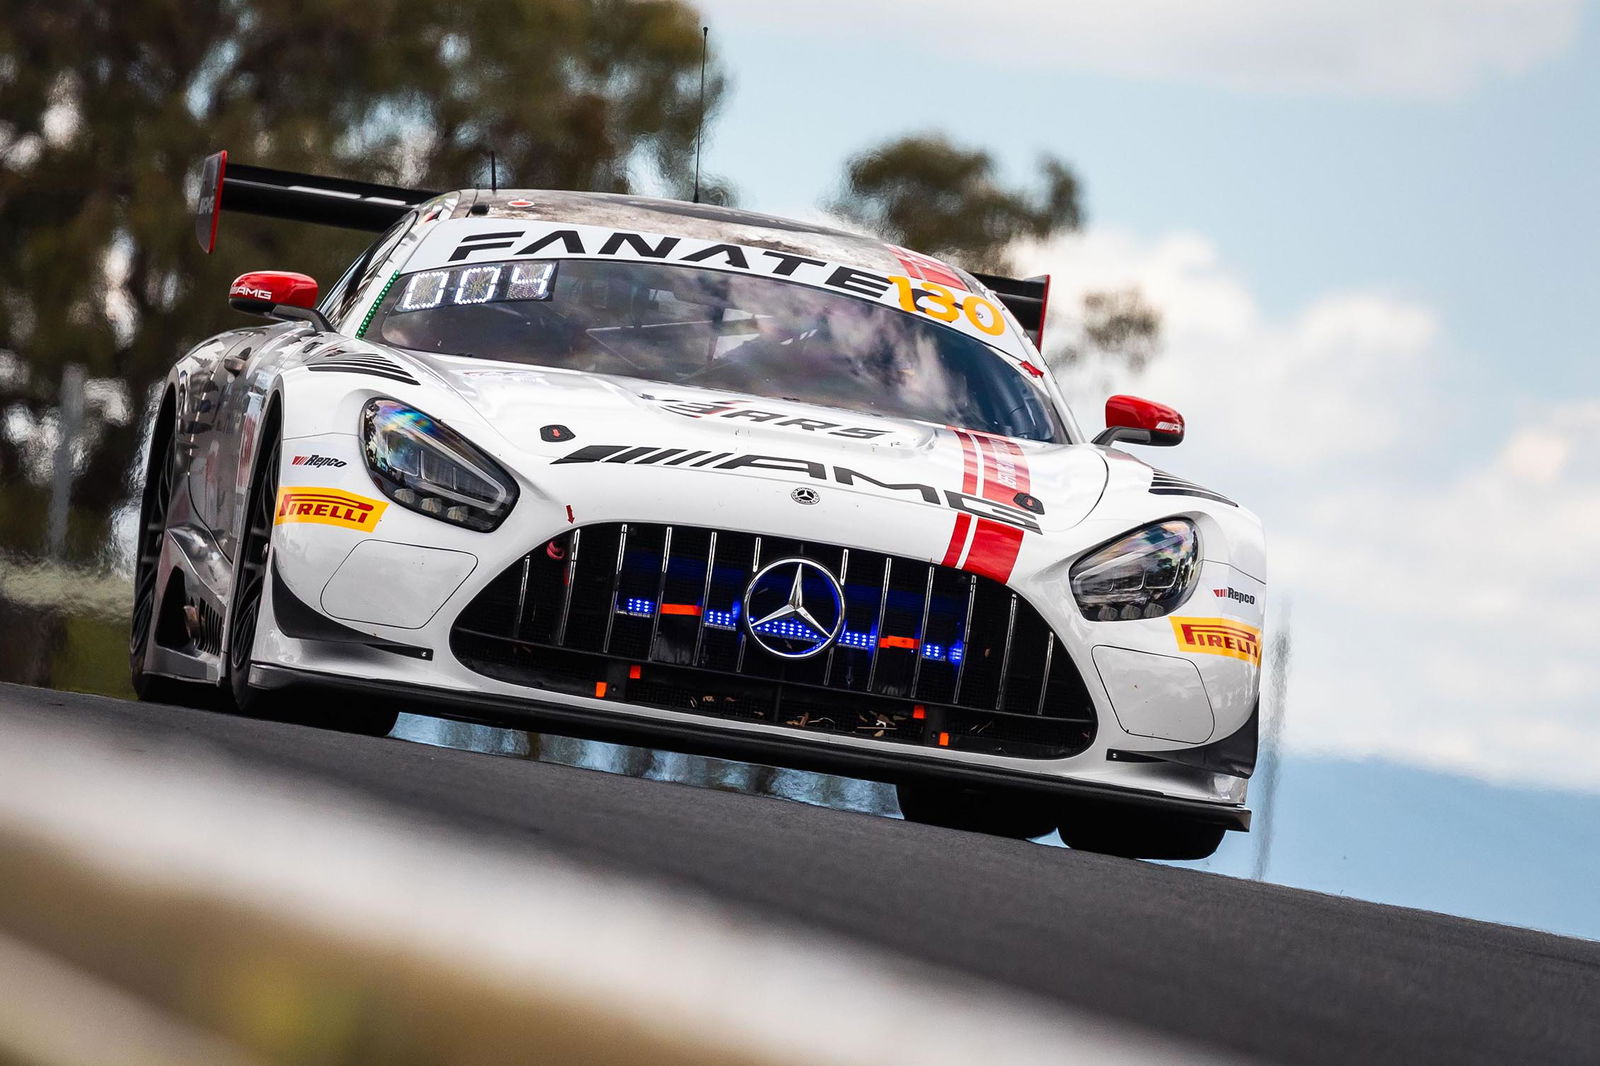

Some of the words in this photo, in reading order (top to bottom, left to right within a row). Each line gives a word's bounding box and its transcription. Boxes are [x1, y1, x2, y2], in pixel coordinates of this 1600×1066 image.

[236, 286, 273, 301] AMG
[402, 262, 554, 309] 004
[887, 275, 1006, 336] 130
[303, 454, 348, 469] Repco
[278, 493, 375, 524] PIRELLI
[713, 452, 1044, 536] AMG
[1227, 586, 1256, 605] Repco
